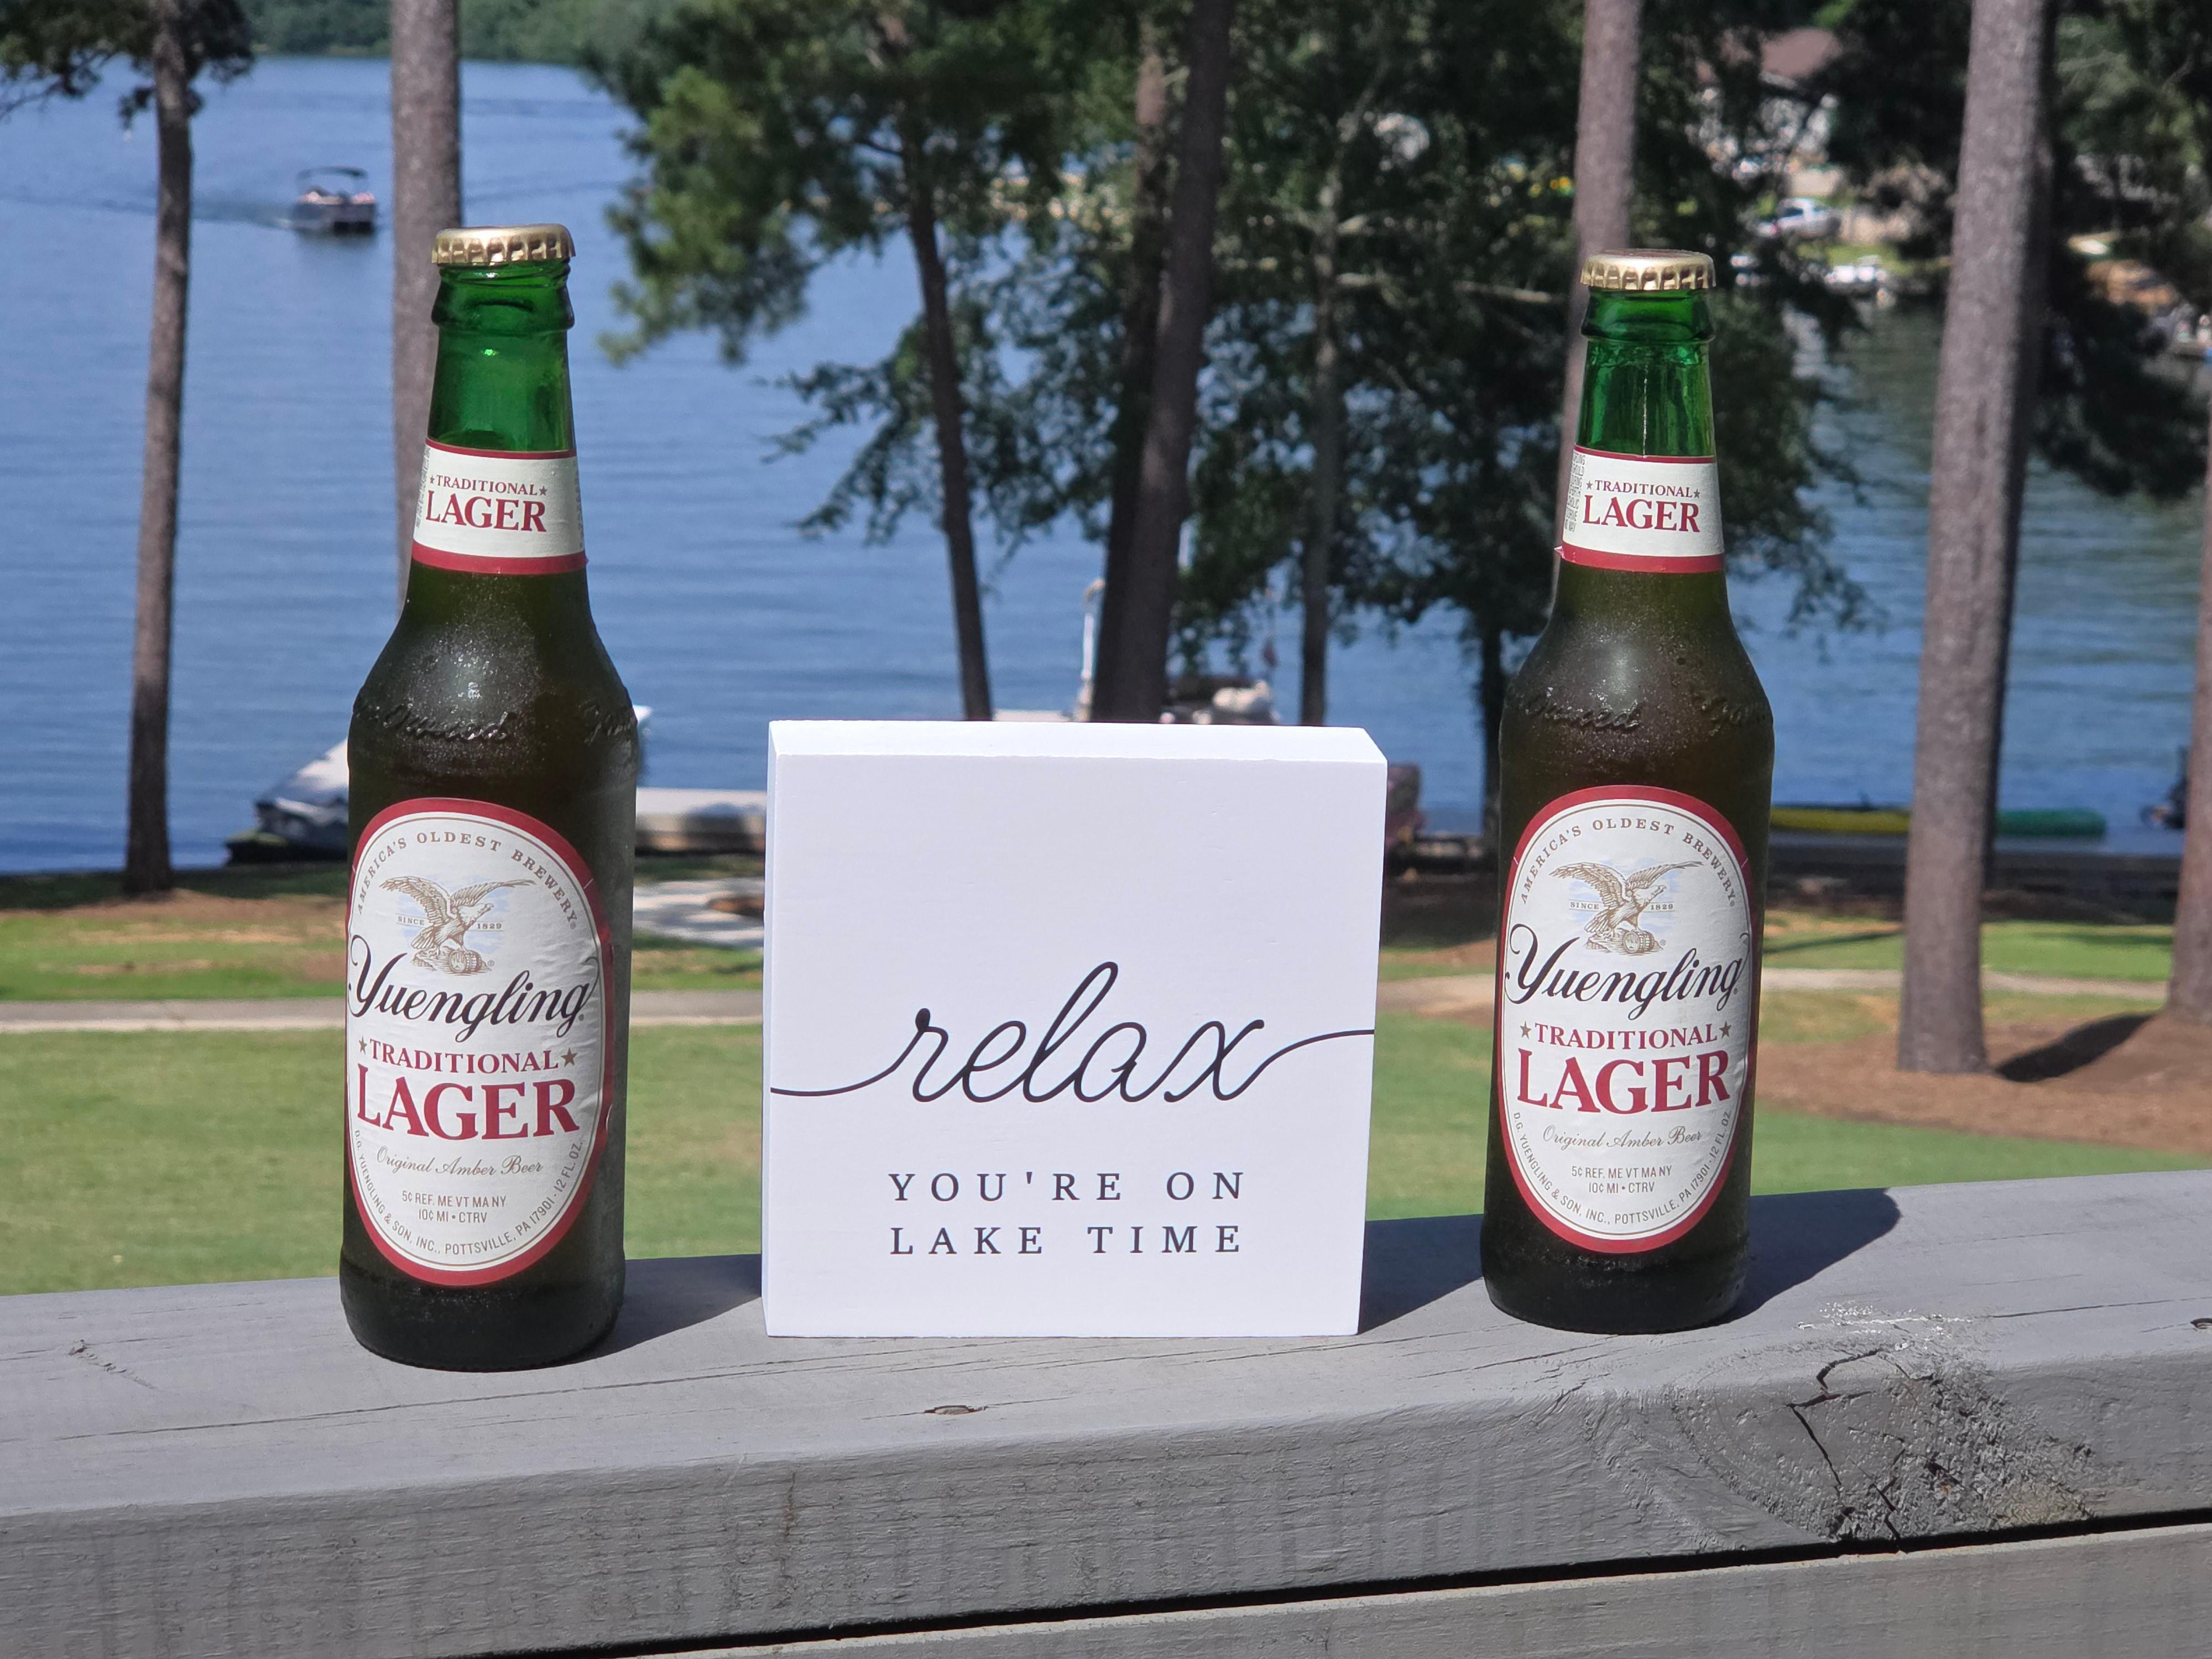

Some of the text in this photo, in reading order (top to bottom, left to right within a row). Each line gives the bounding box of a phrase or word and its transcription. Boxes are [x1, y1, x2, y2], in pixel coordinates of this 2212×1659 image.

[436, 474, 537, 495] TRADITIONAL
[1595, 479, 1692, 498] TRADITIONAL
[426, 490, 546, 532] LAGER
[1583, 494, 1700, 533] LAGER
[358, 837, 406, 915] AMERICA'S
[417, 832, 501, 852] OLDEST
[1521, 825, 1582, 905] AMERICA'S
[1592, 818, 1674, 835] OLDEST
[398, 916, 425, 925] SINCE
[1570, 901, 1599, 910] SINCE
[1504, 924, 1750, 1021] Yuengling
[348, 935, 599, 1042] Yuengling
[771, 961, 1375, 1104] relax
[1535, 1022, 1718, 1050] TRADITIONAL
[369, 1038, 559, 1074] TRADITIONAL
[1517, 1048, 1730, 1114] LAGER
[357, 1063, 580, 1140] LAGER
[1543, 1124, 1703, 1150] Original Amber Beer
[377, 1146, 544, 1176] Original Amber Beer
[1520, 1134, 1553, 1191] YUENGLING
[1551, 1189, 1559, 1199] &
[1678, 1188, 1692, 1203] PA
[1690, 1164, 1710, 1191] 17901
[1709, 1145, 1719, 1159] 12
[1608, 1167, 1623, 1179] ME
[1626, 1167, 1639, 1178] VT
[1641, 1166, 1657, 1178] MA
[1658, 1165, 1673, 1177] NY
[358, 1154, 385, 1215] YUENGLING
[515, 1220, 531, 1236] PA
[529, 1197, 555, 1224] 17901
[554, 1178, 566, 1192] 12
[888, 1171, 1244, 1201] YOU'RE ON
[1606, 1183, 1619, 1193] MI
[437, 1211, 448, 1222] MI
[438, 1195, 453, 1207] ME
[456, 1196, 469, 1208] VT
[472, 1196, 489, 1208] MA
[492, 1195, 507, 1208] NY
[889, 1225, 1240, 1255] LAKE TIME
